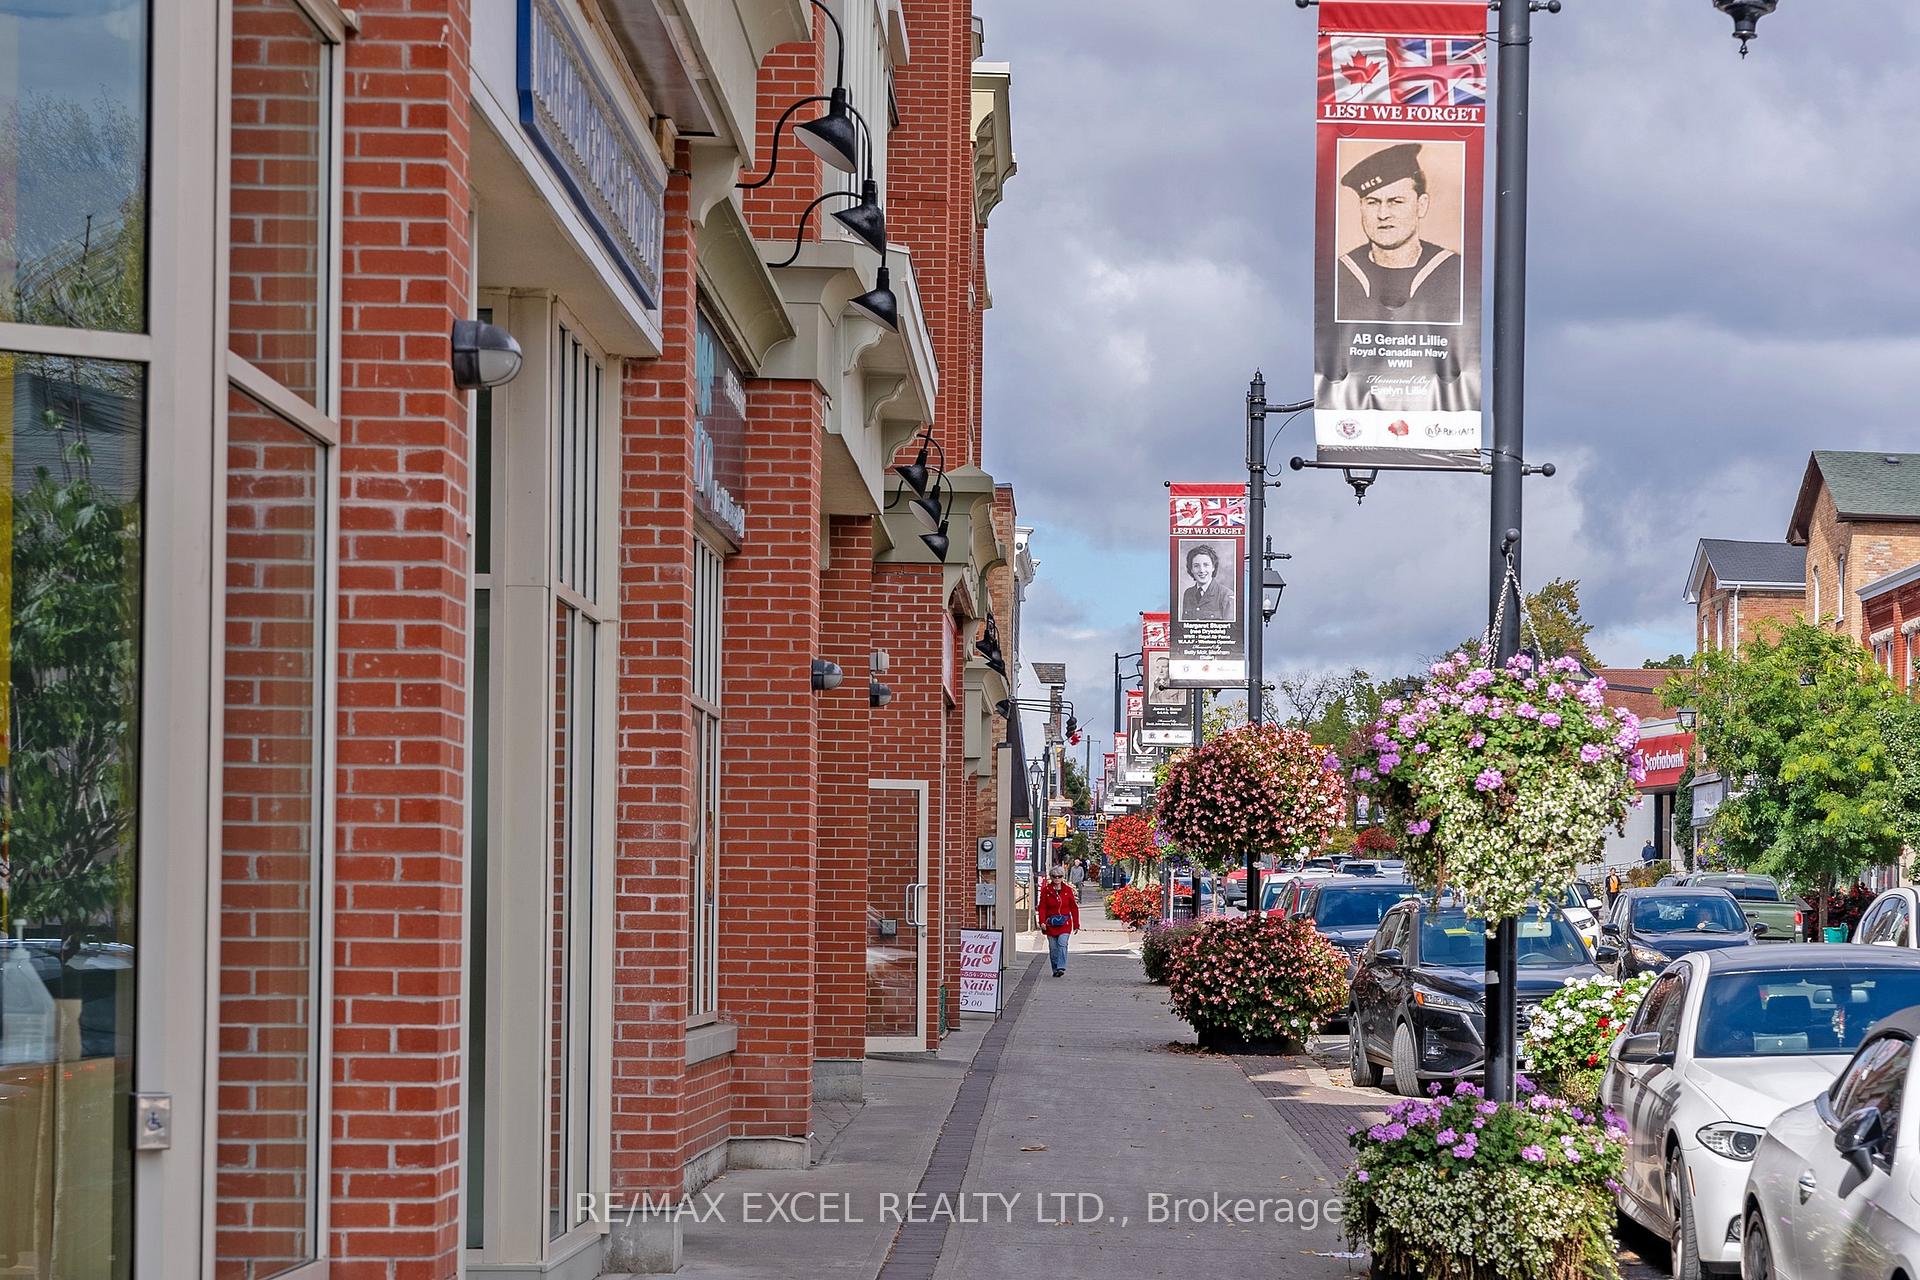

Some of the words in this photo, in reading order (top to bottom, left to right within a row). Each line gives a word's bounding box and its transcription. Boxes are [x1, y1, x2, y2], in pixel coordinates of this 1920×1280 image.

[1324, 104, 1368, 120] LEST
[1373, 105, 1402, 120] WE
[1406, 106, 1480, 121] FORGET
[1352, 334, 1372, 345] AB
[1375, 334, 1416, 346] Gerald
[1419, 334, 1448, 346] Lillie
[1349, 347, 1377, 357] Royal
[1378, 347, 1422, 357] Canadian
[1425, 348, 1448, 359] Navy
[1388, 359, 1413, 368] WWII
[1370, 386, 1403, 397] Evelyn
[1172, 527, 1193, 535] LEST
[1194, 527, 1208, 535] WE
[1209, 527, 1243, 535] FORGET
[1645, 749, 1685, 771] Scotiabank
[961, 955, 982, 970] pa
[962, 980, 994, 991] Nails
